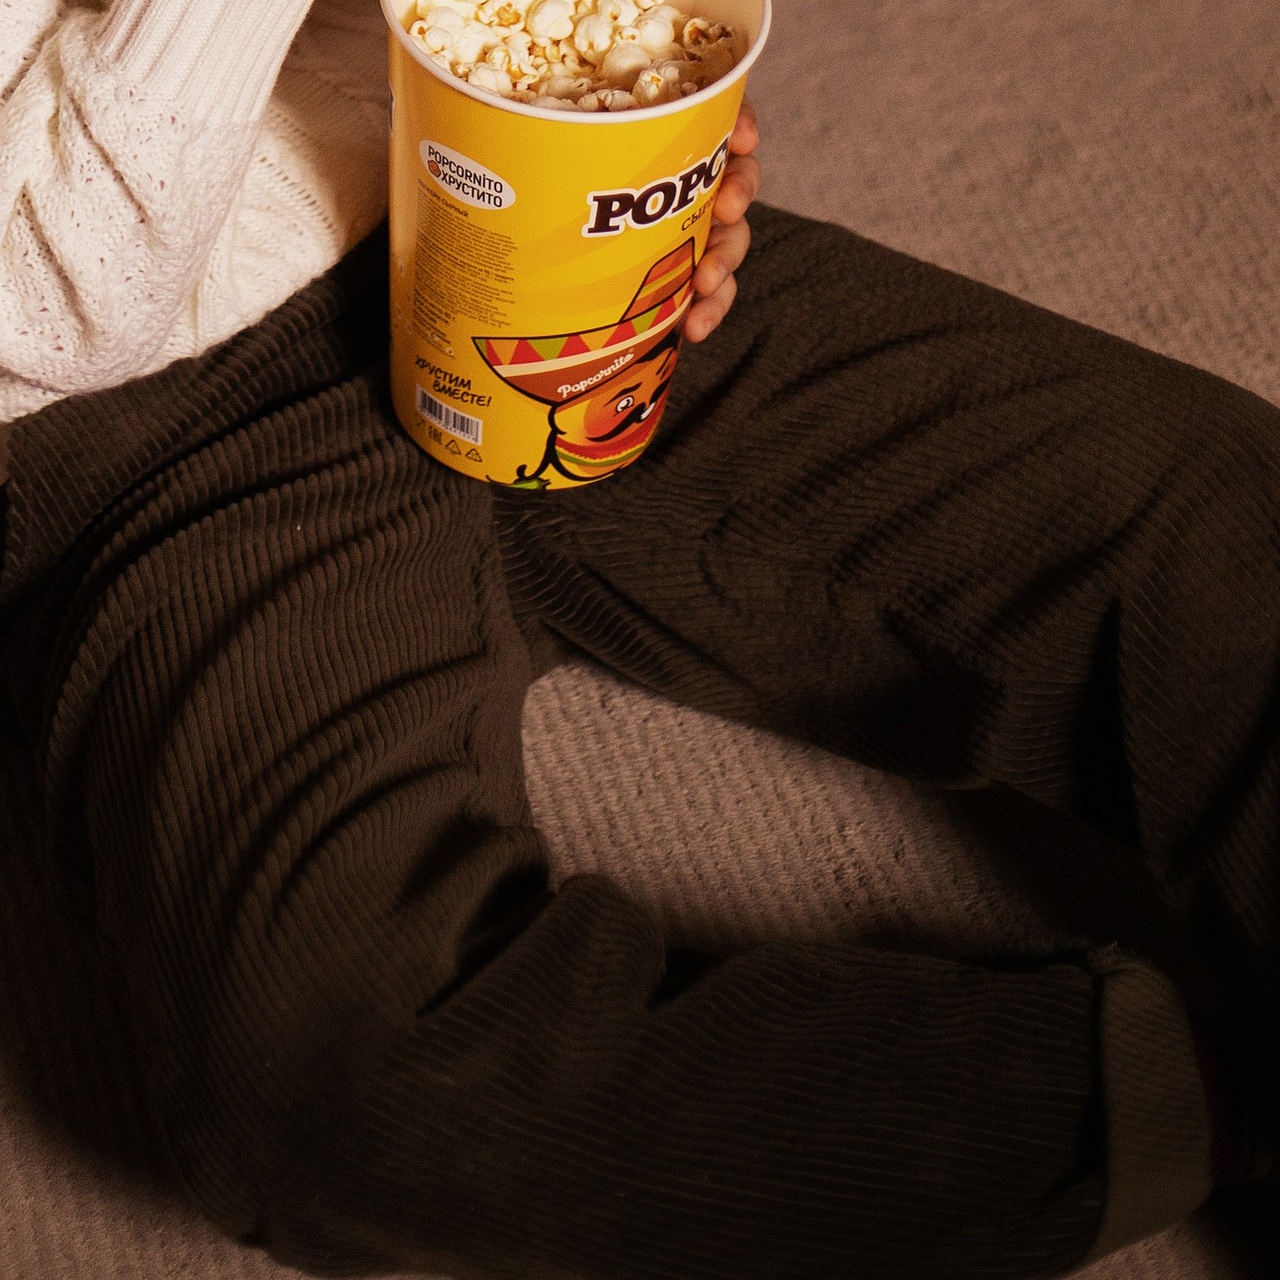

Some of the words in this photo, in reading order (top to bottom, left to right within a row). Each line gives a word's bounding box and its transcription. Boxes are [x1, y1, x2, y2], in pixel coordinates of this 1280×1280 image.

[441, 170, 503, 208] ХРУСТИТО
[587, 136, 729, 234] POPC
[415, 355, 471, 390] ХРУСТИМ
[557, 353, 635, 398] Popcornito
[433, 380, 492, 407] ВМЕСТЕ!
